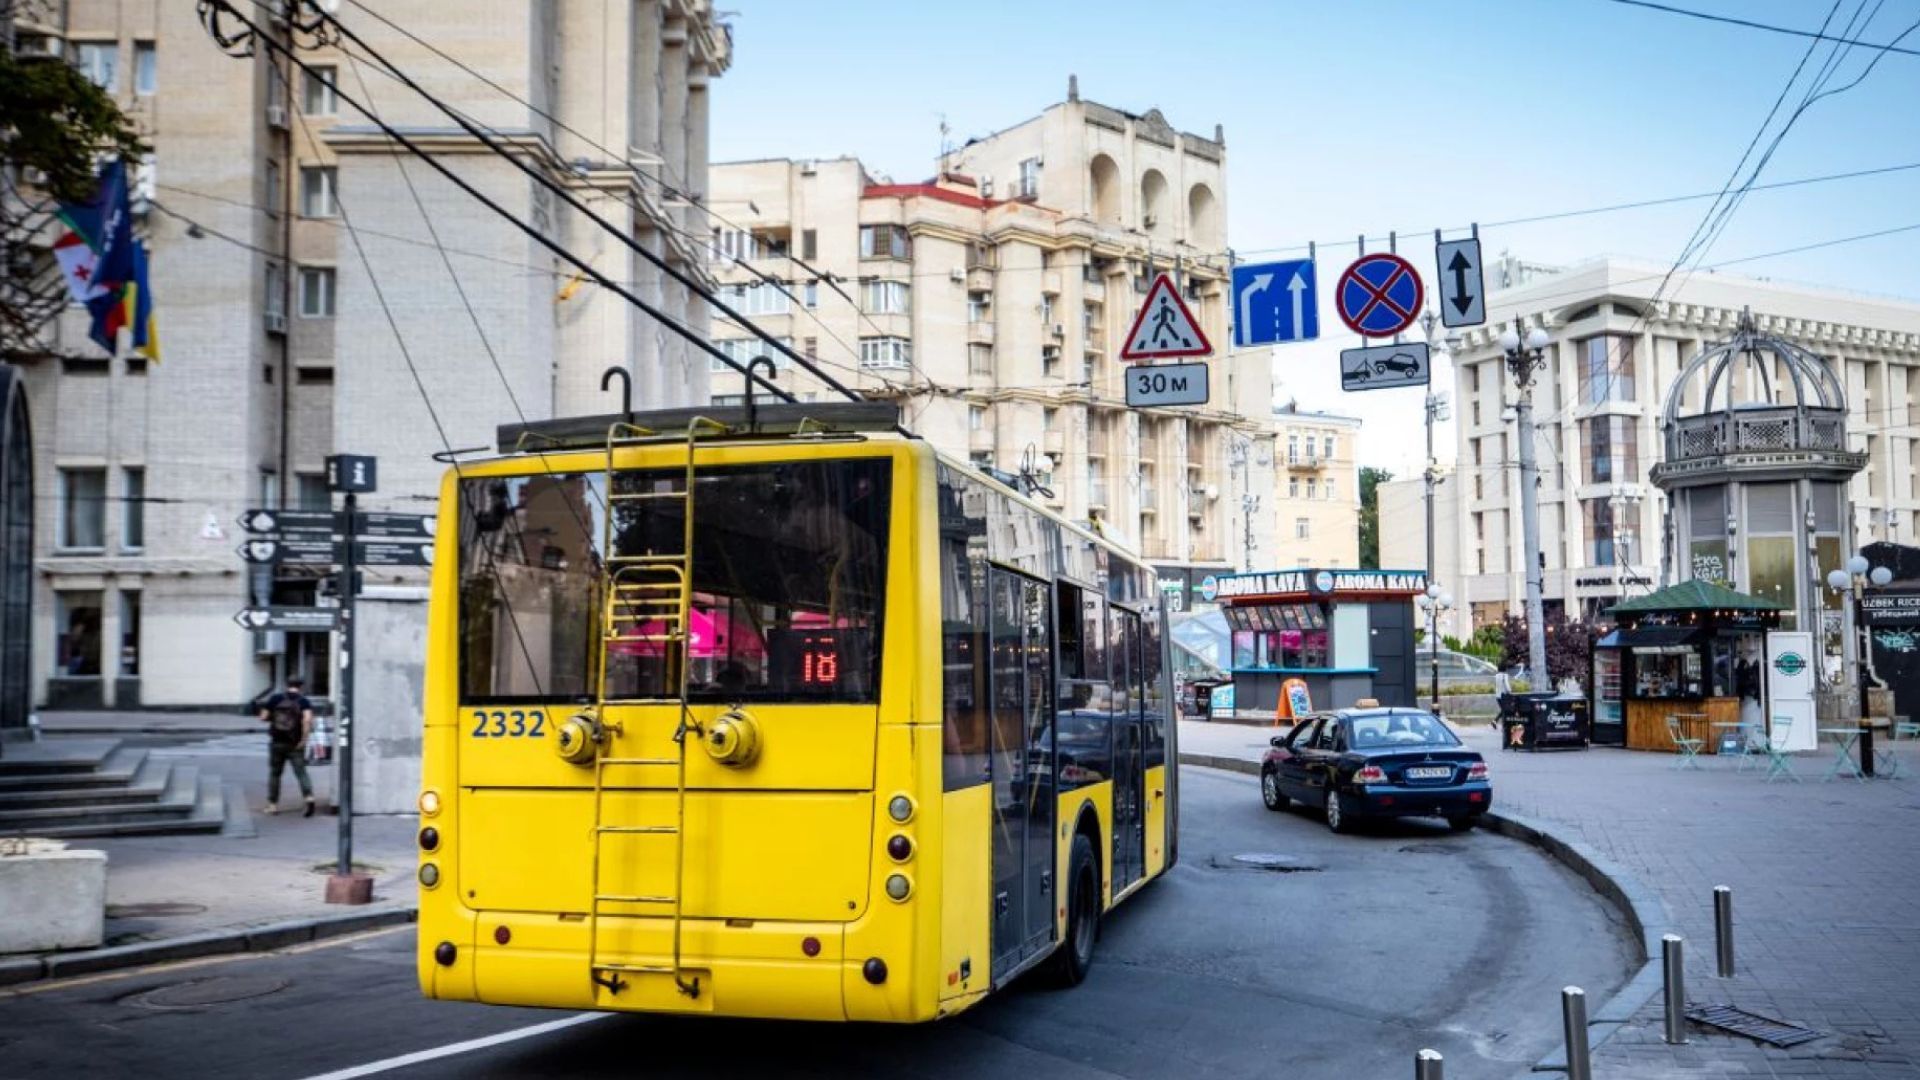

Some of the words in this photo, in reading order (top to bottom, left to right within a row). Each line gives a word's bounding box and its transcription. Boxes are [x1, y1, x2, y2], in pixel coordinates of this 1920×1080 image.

[1138, 373, 1167, 395] 30
[1333, 574, 1384, 590] AROMA
[1862, 598, 1894, 608] UZBEK
[473, 711, 545, 737] 2332
